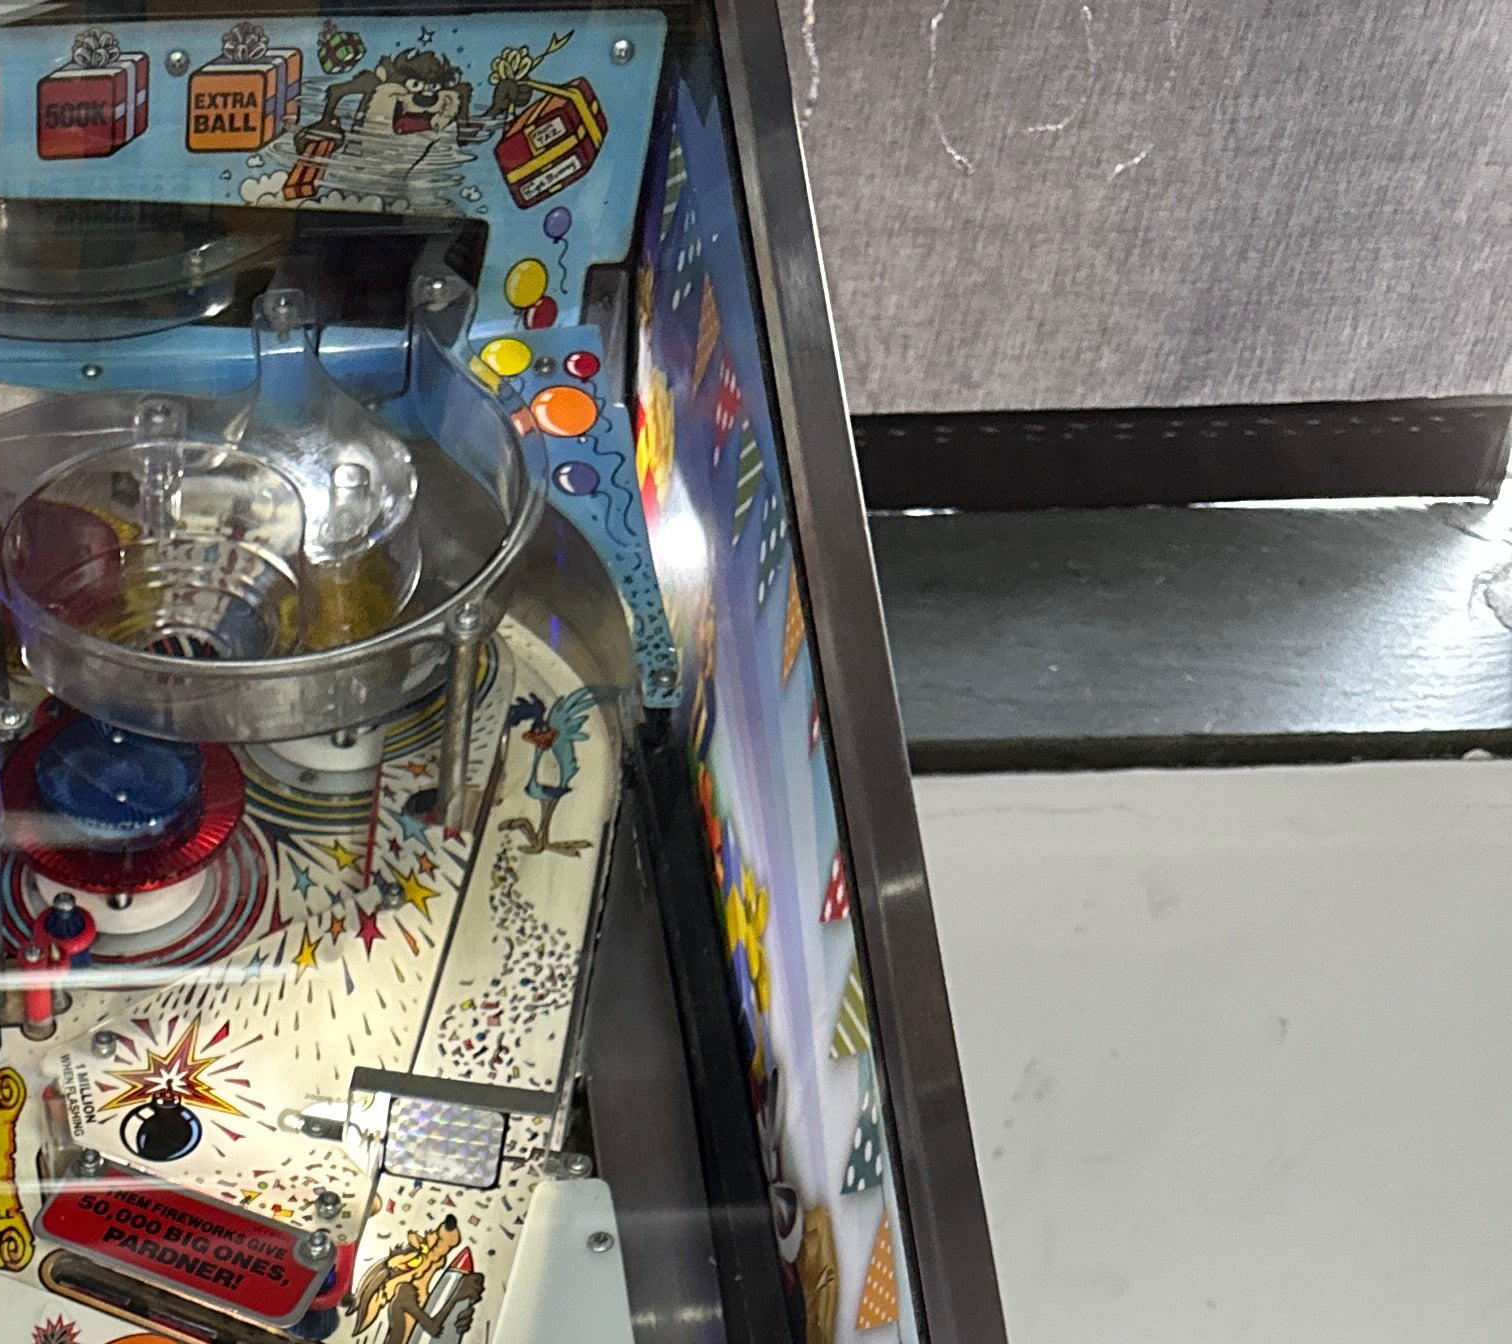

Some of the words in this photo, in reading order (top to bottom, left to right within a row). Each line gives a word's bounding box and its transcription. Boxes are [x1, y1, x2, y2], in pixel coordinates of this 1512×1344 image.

[193, 111, 257, 135] BALL
[195, 91, 258, 110] EXTRA
[77, 1194, 163, 1235] 50,000
[163, 1226, 210, 1254] BIG
[213, 1244, 290, 1287] ONES,
[103, 1226, 243, 1291] PARDNER!
[152, 1202, 247, 1245] FIREWORKS
[247, 1235, 287, 1260] GIVE
